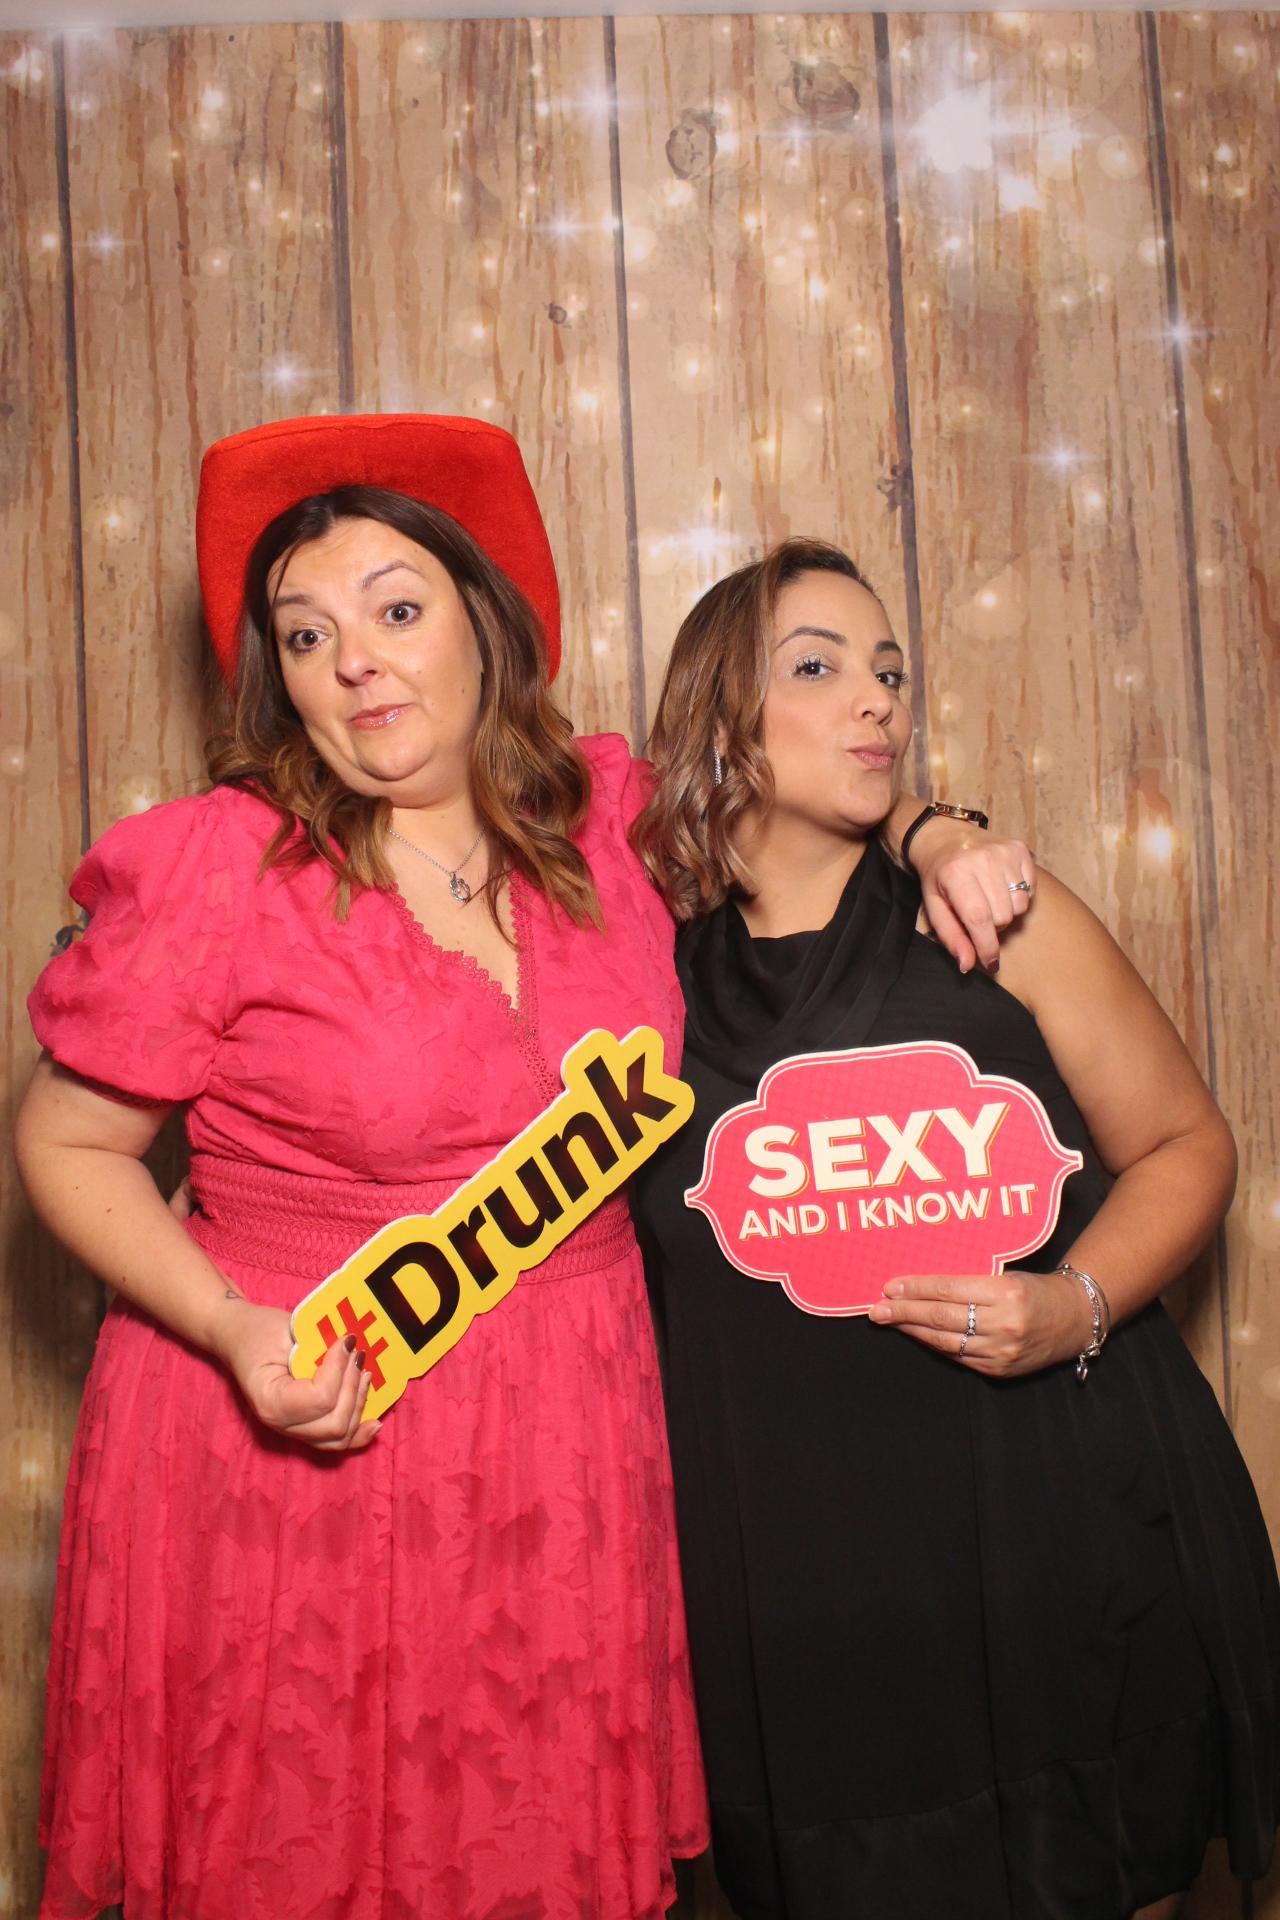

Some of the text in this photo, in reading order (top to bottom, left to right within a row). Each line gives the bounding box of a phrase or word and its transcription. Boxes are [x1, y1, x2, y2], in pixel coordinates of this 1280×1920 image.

[744, 1102, 1010, 1199] SEXY
[315, 1052, 677, 1392] #Drunk
[738, 1183, 1037, 1241] AND I KNOW IT
